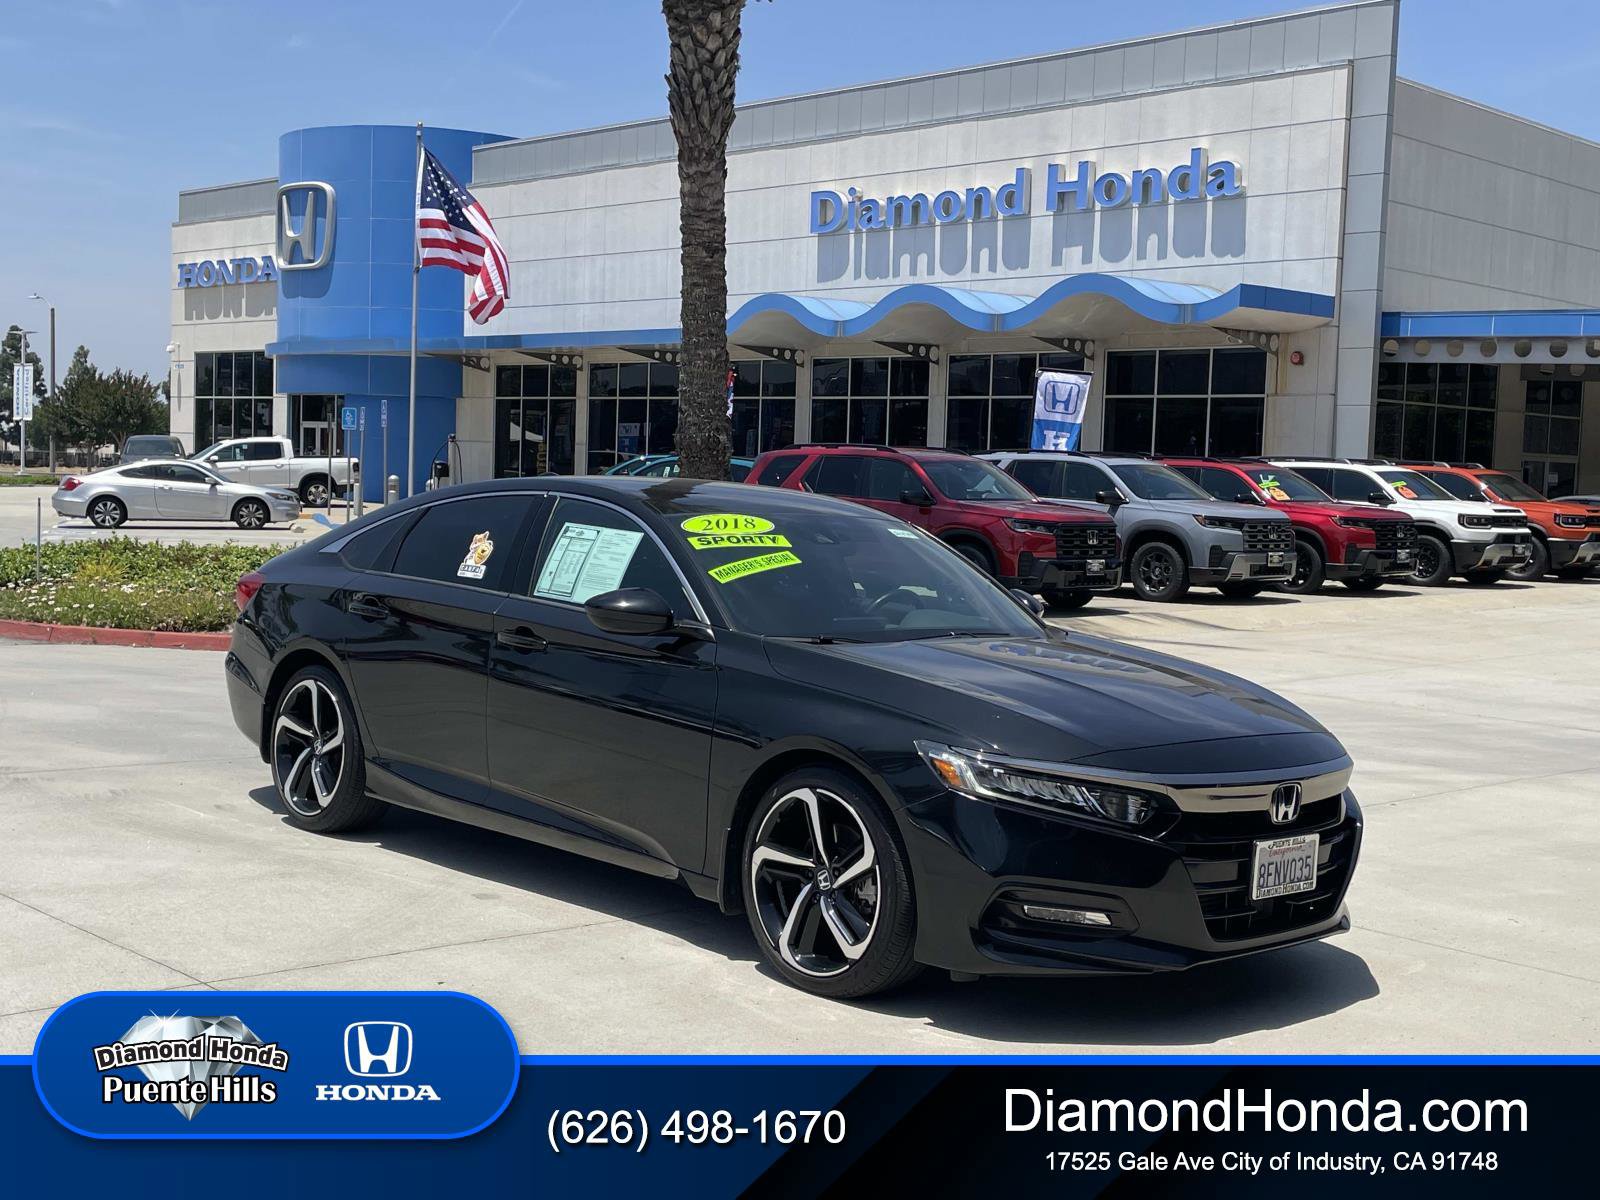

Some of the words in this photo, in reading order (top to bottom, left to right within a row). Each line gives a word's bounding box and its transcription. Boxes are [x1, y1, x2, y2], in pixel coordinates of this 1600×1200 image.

[810, 167, 1032, 235] Diamond
[1046, 147, 1246, 212] Honda
[178, 255, 278, 288] HONDA
[702, 517, 756, 531] 2018
[697, 535, 779, 546] SPORTY
[714, 558, 763, 580] MANAGER'S
[762, 552, 794, 567] SPECIAL
